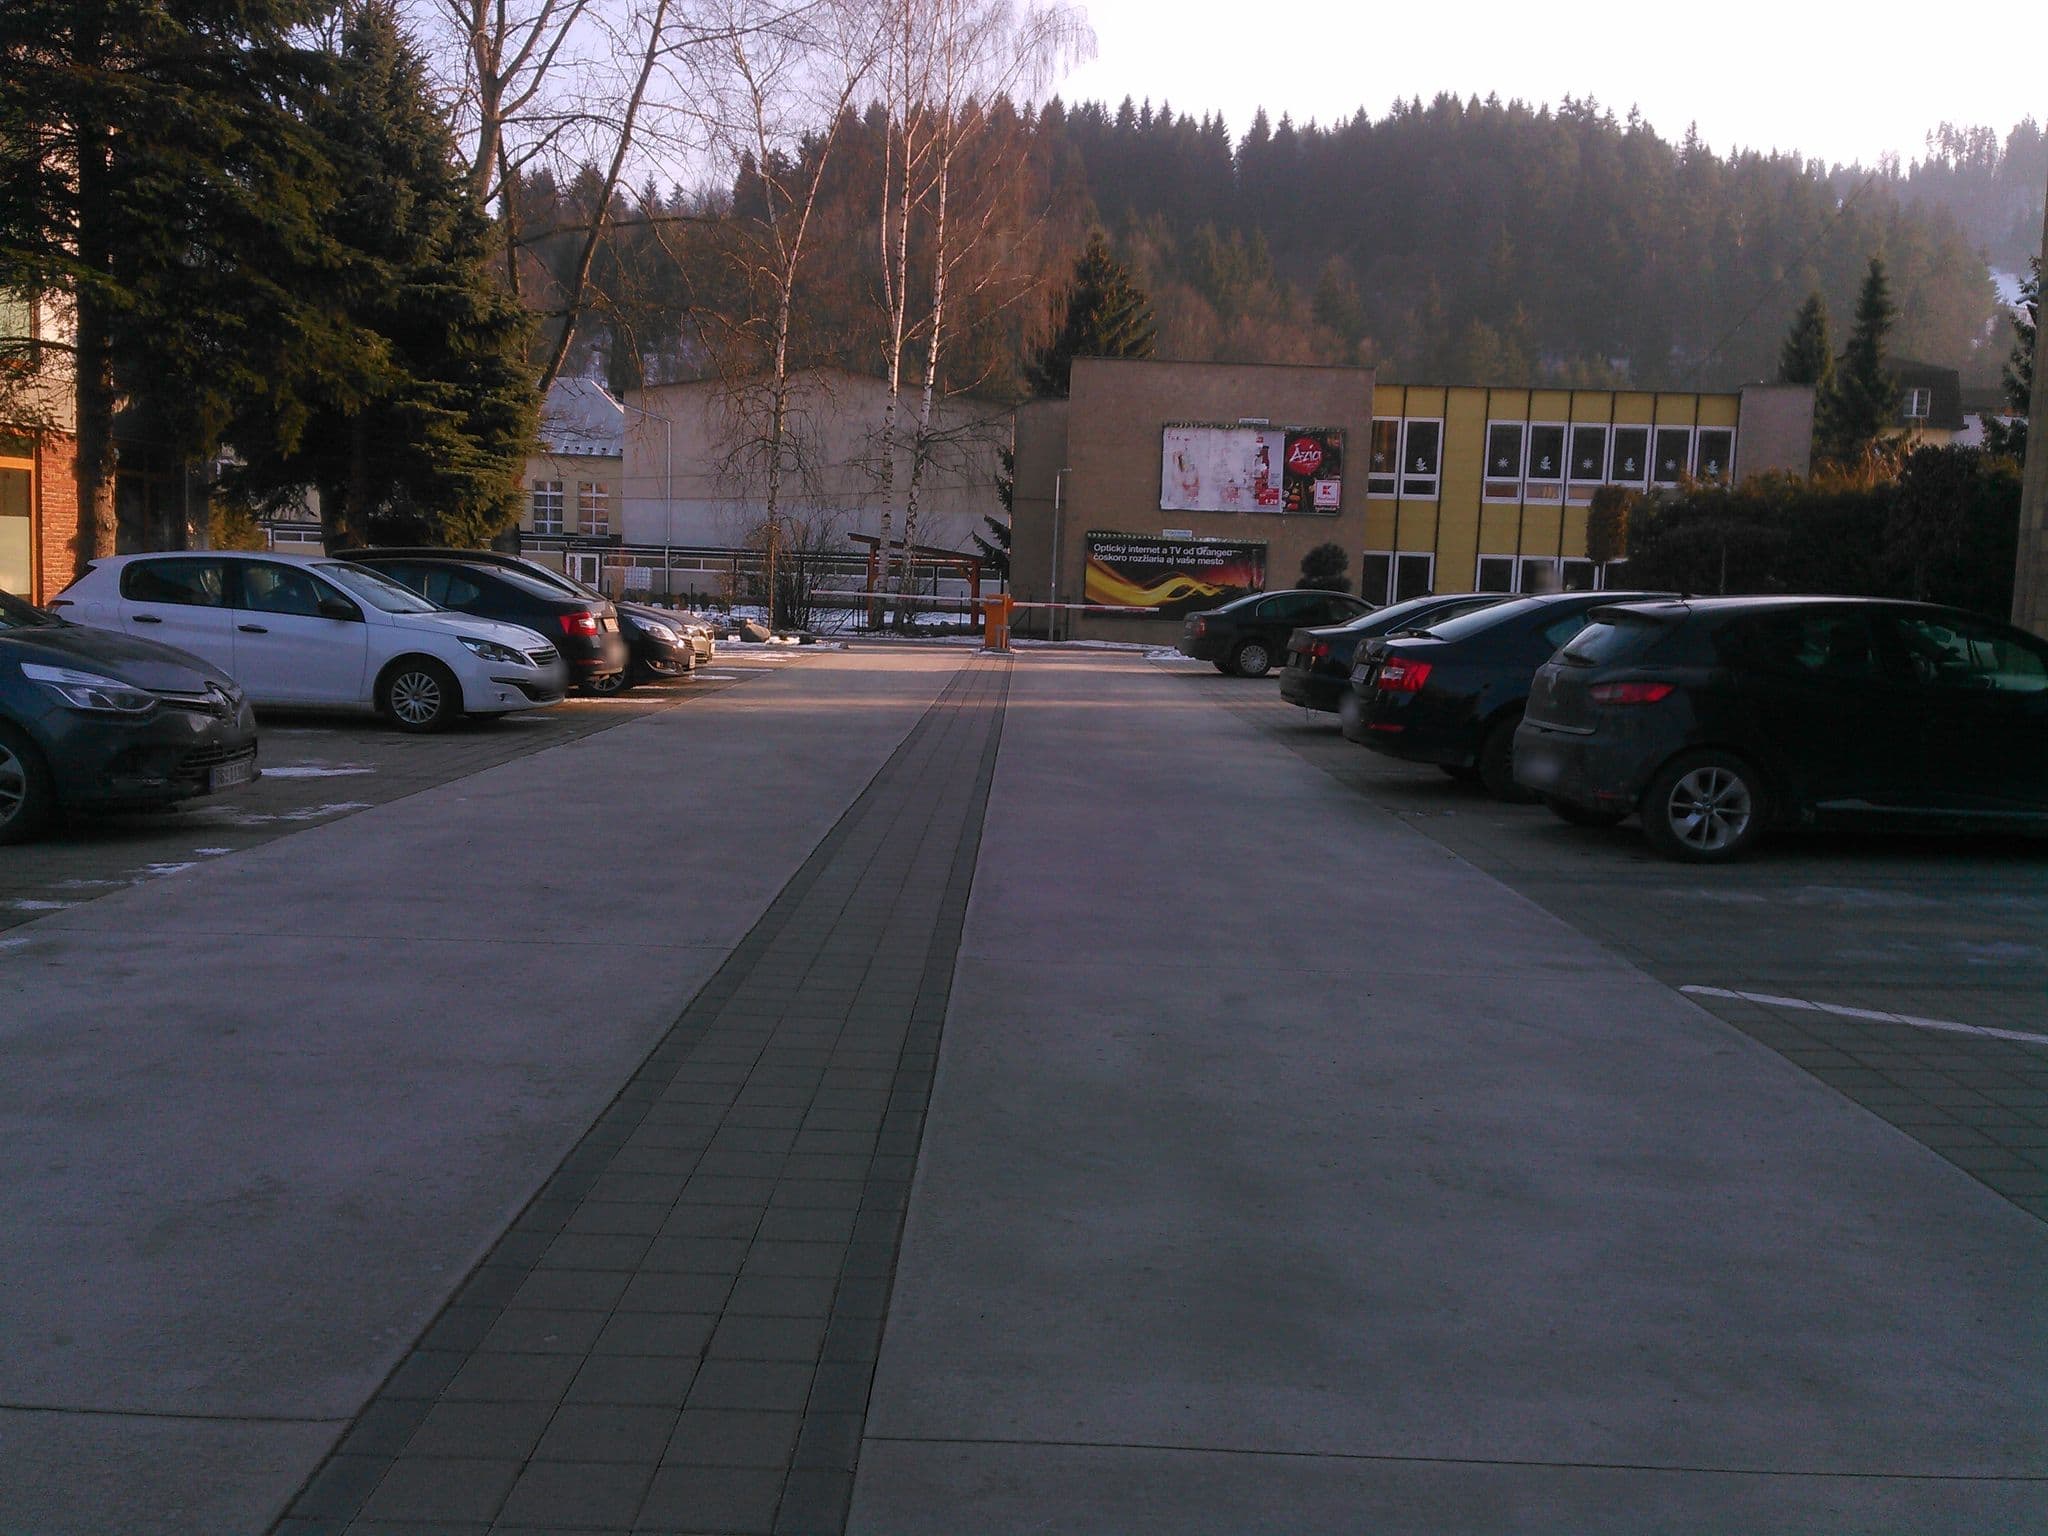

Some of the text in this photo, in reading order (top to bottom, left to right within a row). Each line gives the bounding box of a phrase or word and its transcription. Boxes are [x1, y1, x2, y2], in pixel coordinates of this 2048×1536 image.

[1093, 543, 1126, 554] Optický
[1128, 545, 1160, 554] internet
[1169, 546, 1182, 555] TV
[1183, 547, 1194, 555] od
[1093, 552, 1225, 566] čoskoro rozžiaria aj vaše mesto
